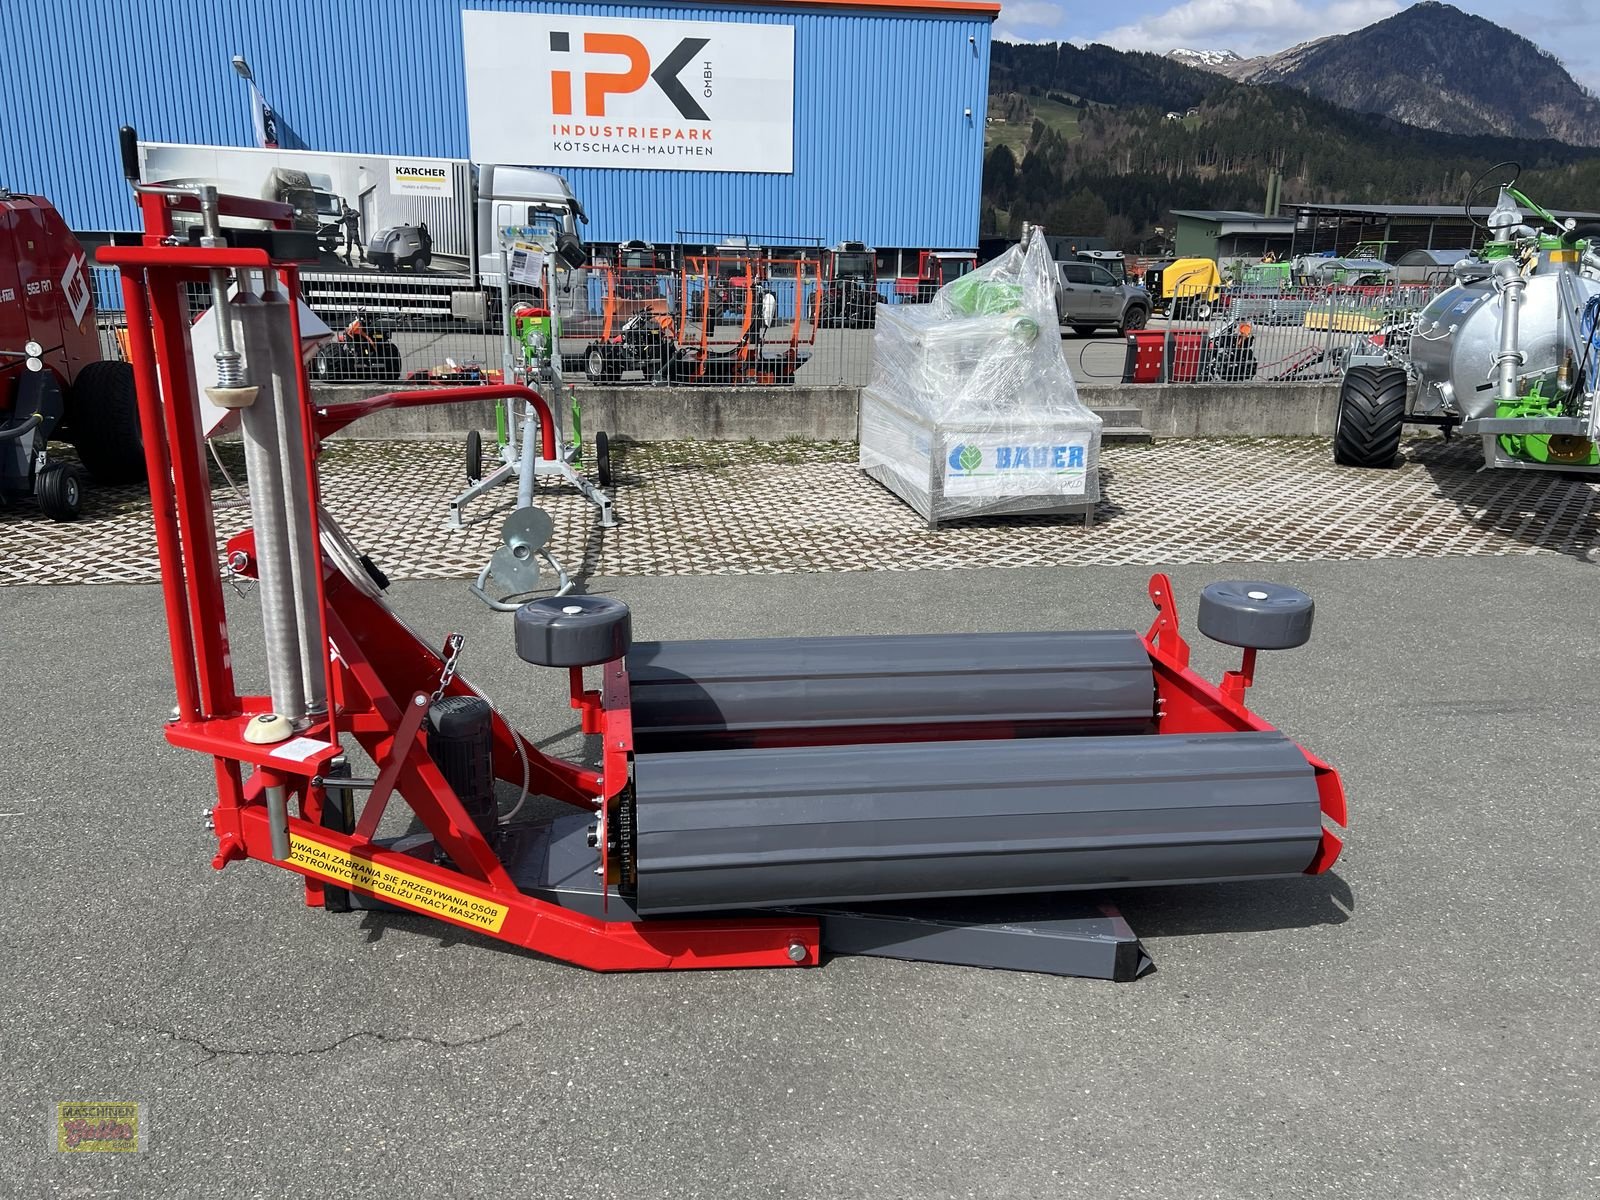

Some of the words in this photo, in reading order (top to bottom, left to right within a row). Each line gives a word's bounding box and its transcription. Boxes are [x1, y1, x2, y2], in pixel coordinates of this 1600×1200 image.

[703, 61, 713, 98] GMBH
[552, 124, 712, 140] INDUSTRIEPARK
[553, 141, 713, 156] KÖTSCHACH-MAUTHEN
[395, 166, 446, 177] KÄRCHER
[26, 282, 40, 295] 562
[995, 446, 1084, 469] BAUER
[290, 840, 331, 861] UWAGA!
[331, 855, 381, 879] ZABRANIA
[383, 873, 400, 885] SIĘ
[400, 879, 468, 908] PRZEBYWANIA
[470, 902, 498, 917] OSÓB
[291, 851, 358, 881] OSTRONNYCH
[360, 875, 370, 885] W
[371, 880, 413, 900] POBLIŻU
[414, 893, 448, 910] PRACY
[448, 905, 494, 926] MASZYNY
